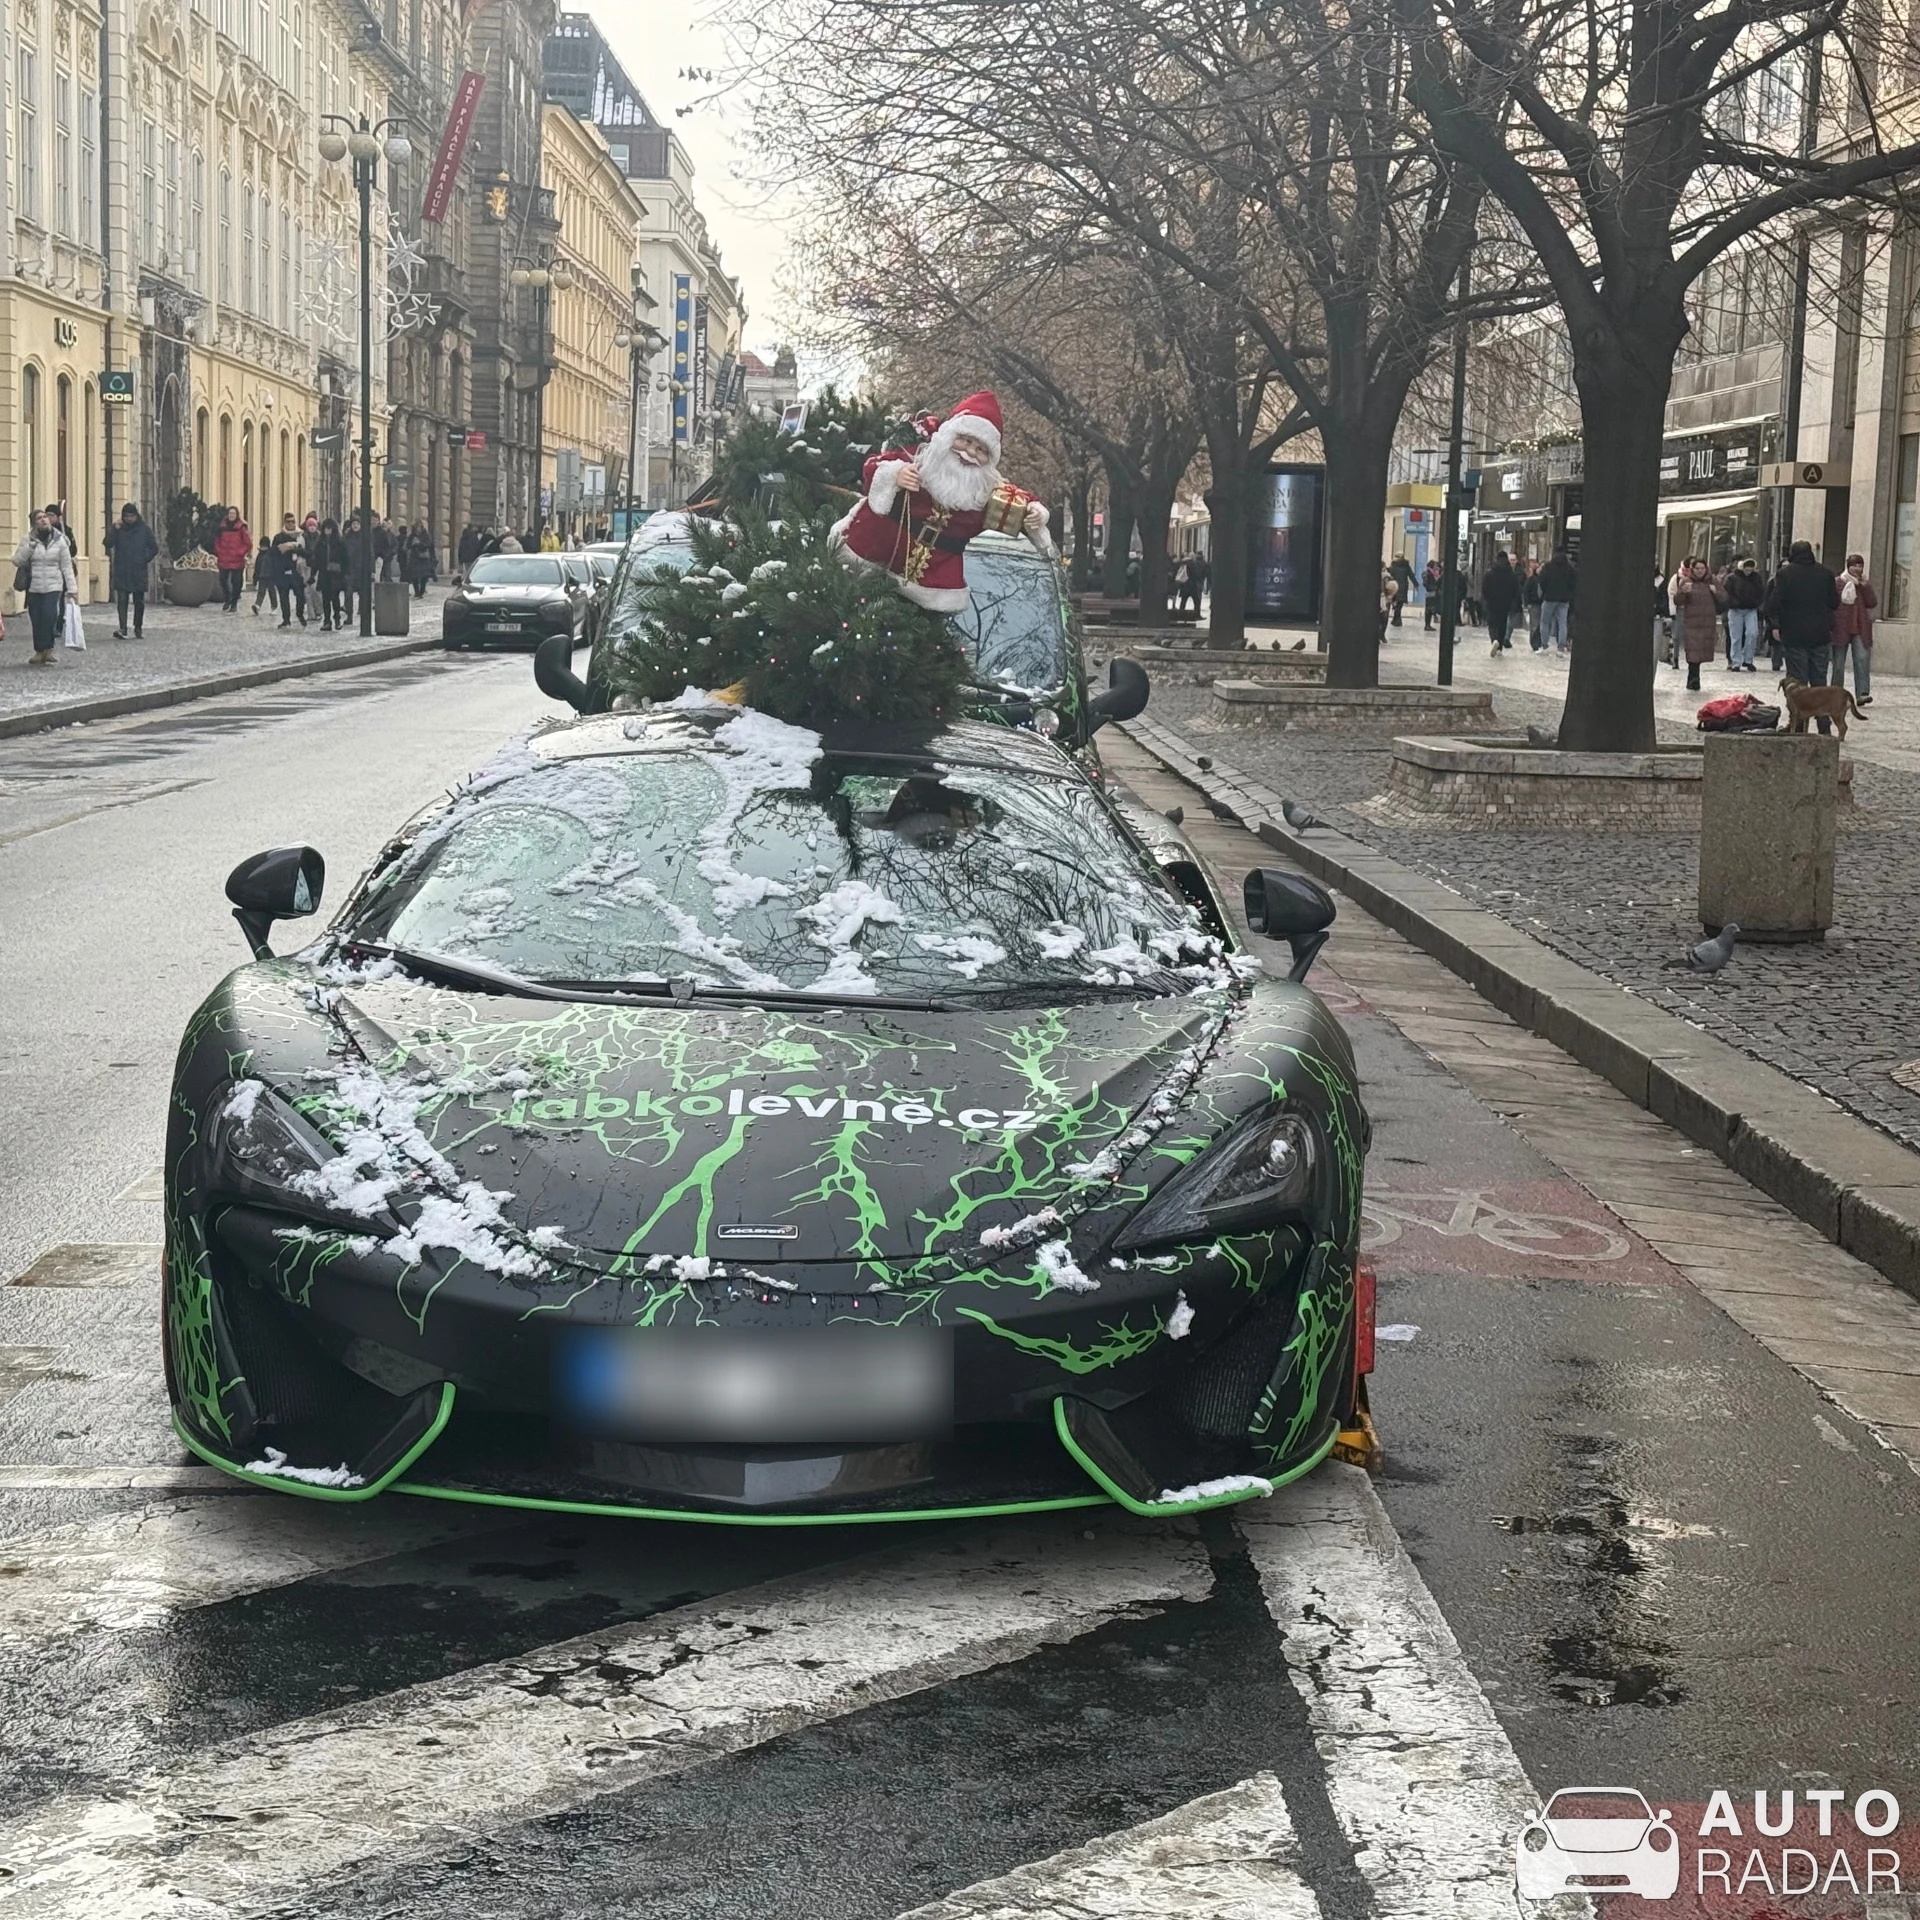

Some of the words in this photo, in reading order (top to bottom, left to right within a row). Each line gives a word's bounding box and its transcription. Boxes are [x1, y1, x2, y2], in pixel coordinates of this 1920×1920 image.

[464, 78, 477, 104] ART
[446, 108, 468, 161] PALACE
[429, 163, 450, 217] PRAGUE
[54, 317, 78, 348] IQOS
[697, 327, 706, 347] THE
[102, 393, 132, 402] IQOS
[695, 349, 706, 417] PLAYGROUND
[1688, 449, 1716, 480] PAUL
[1806, 466, 1819, 480] A
